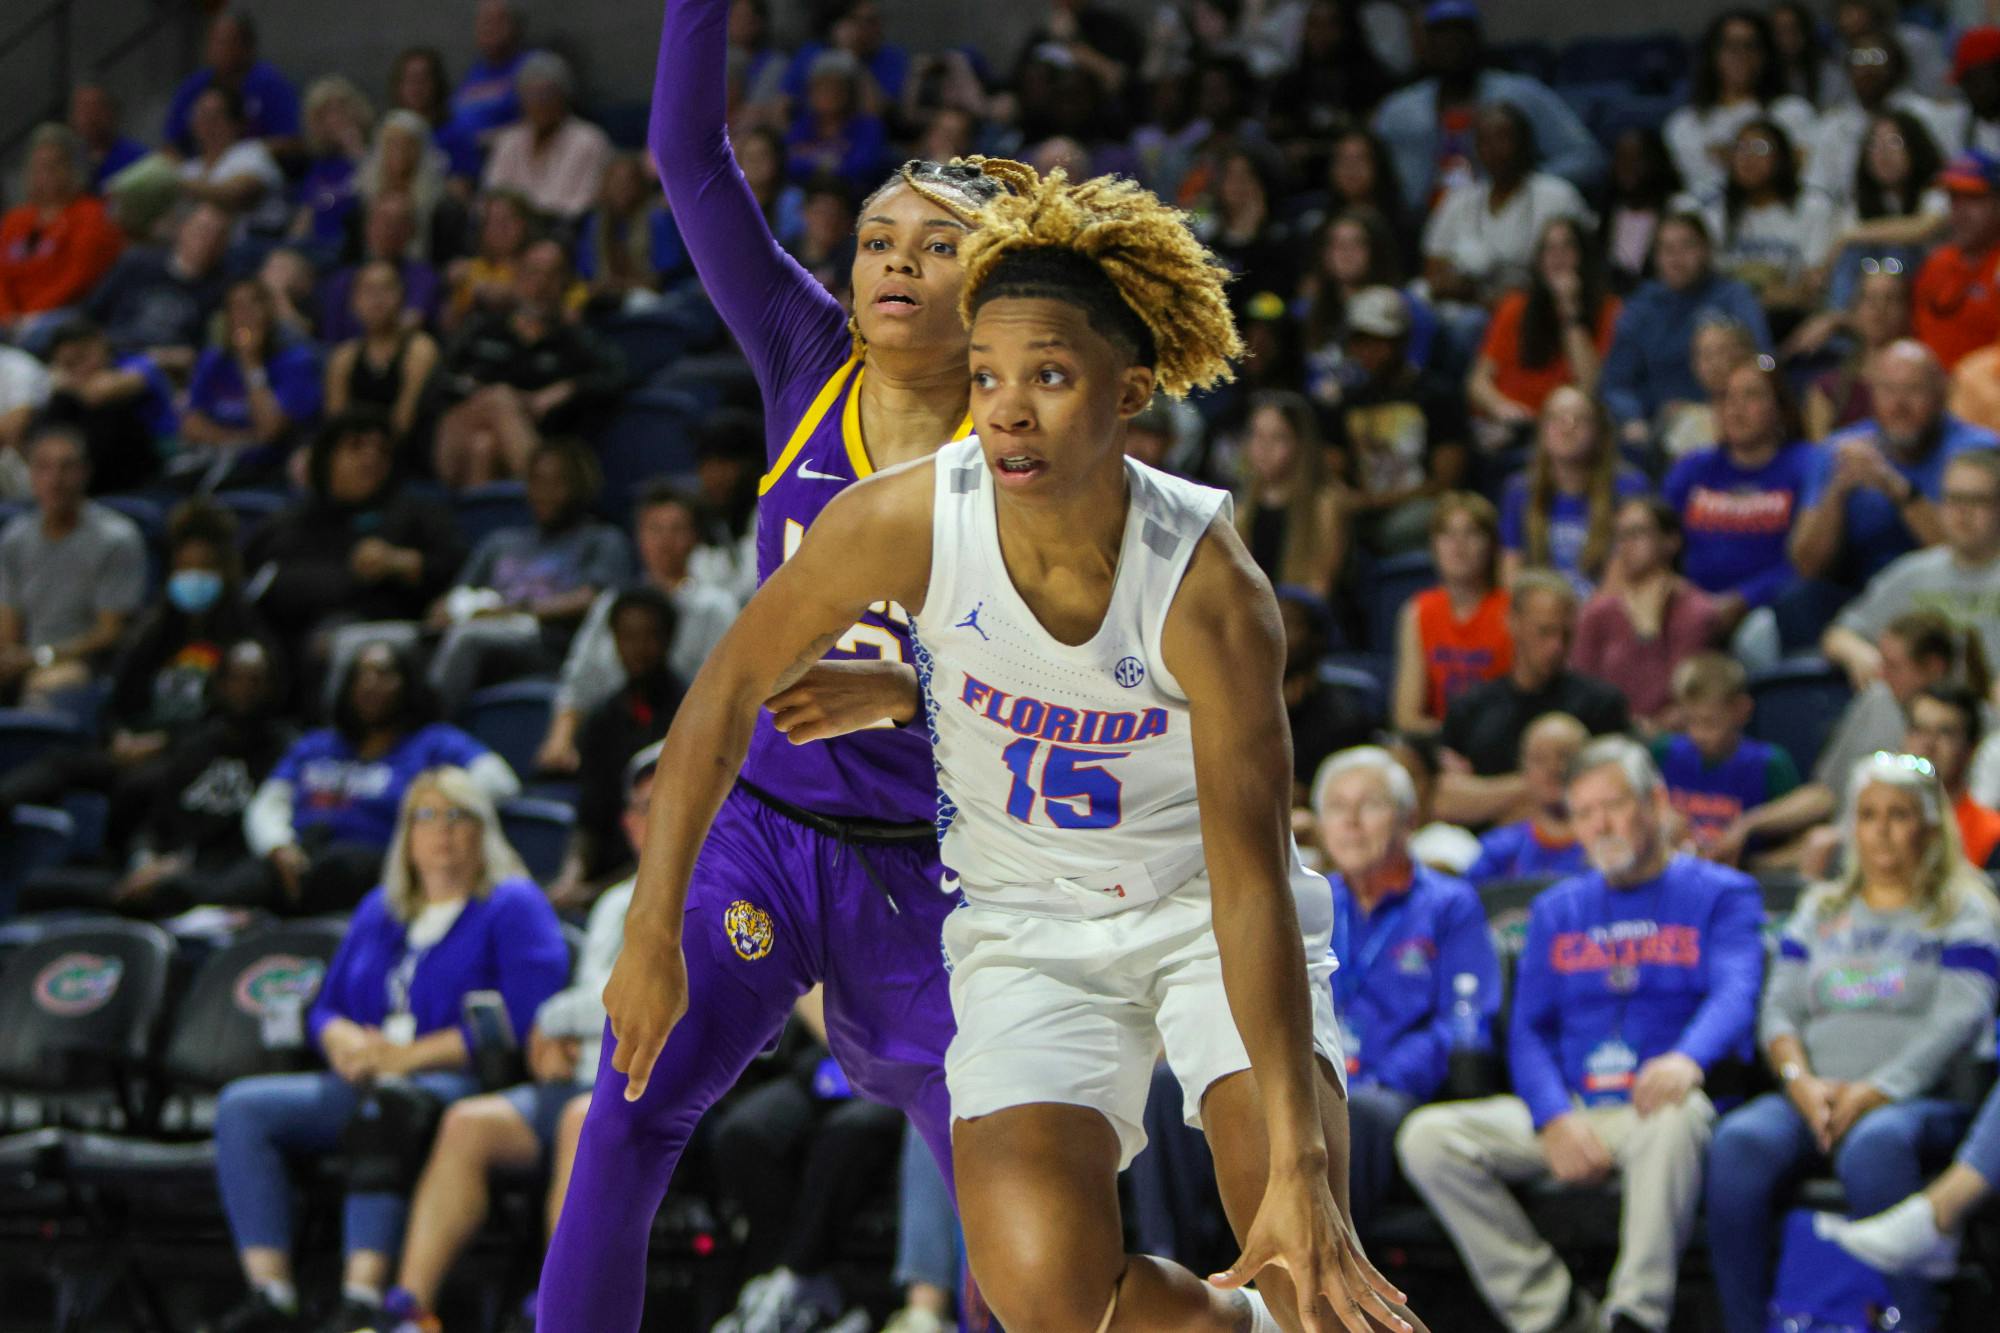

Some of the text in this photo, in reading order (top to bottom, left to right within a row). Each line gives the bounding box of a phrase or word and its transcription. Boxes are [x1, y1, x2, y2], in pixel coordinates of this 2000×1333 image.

[958, 671, 1169, 745] FLORIDA
[1115, 659, 1143, 686] SEC
[1002, 737, 1132, 829] 15
